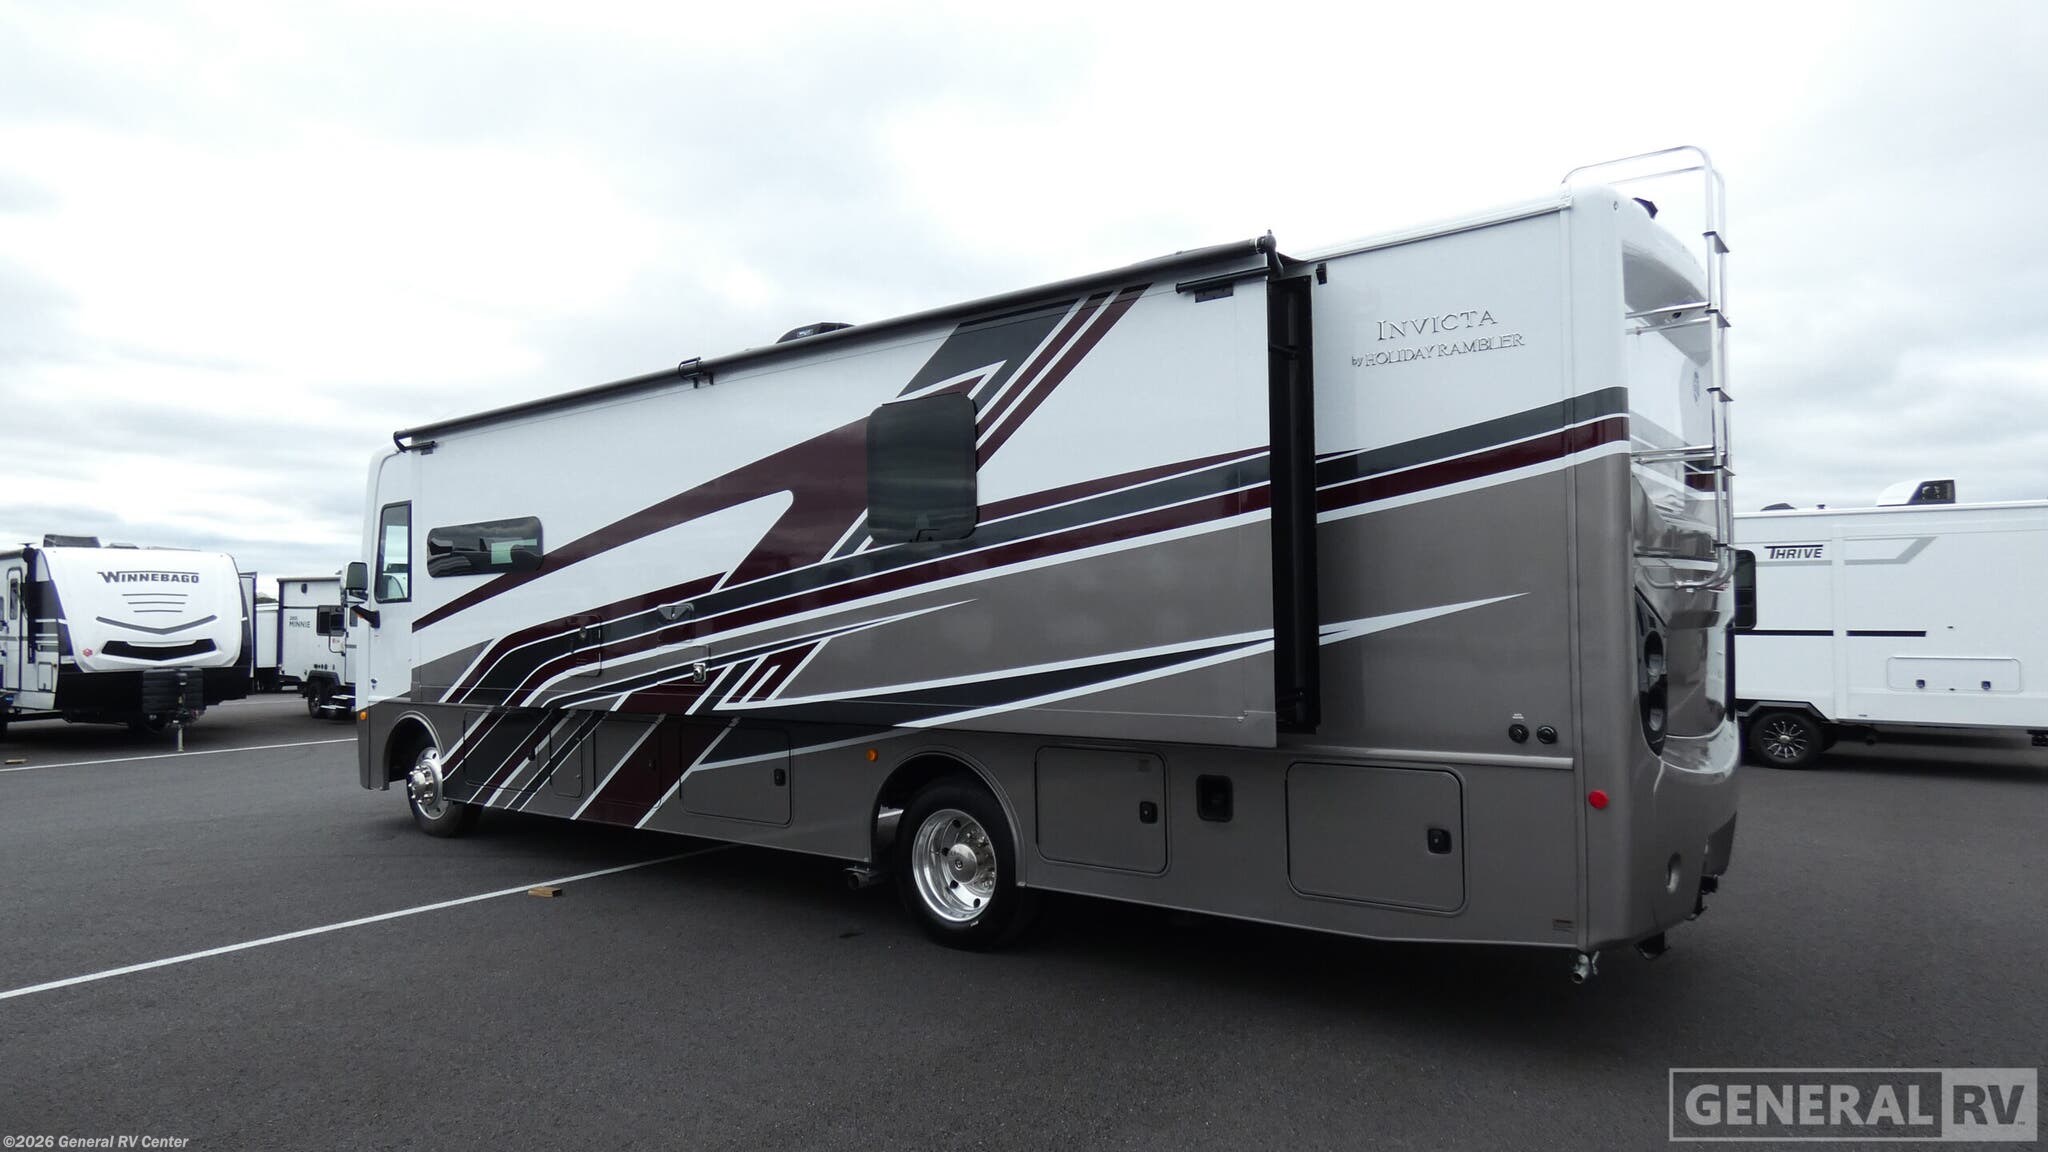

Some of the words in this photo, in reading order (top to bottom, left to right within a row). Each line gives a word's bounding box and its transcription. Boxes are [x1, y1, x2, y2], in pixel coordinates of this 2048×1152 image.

[1376, 309, 1498, 342] INVICTA
[1351, 355, 1364, 367] by
[1364, 343, 1437, 367] HOLIDAY
[1437, 332, 1526, 358] RAMBLER
[1764, 544, 1823, 559] THRIVE
[97, 570, 200, 584] WINNEBAGO
[289, 620, 311, 629] MINNIE
